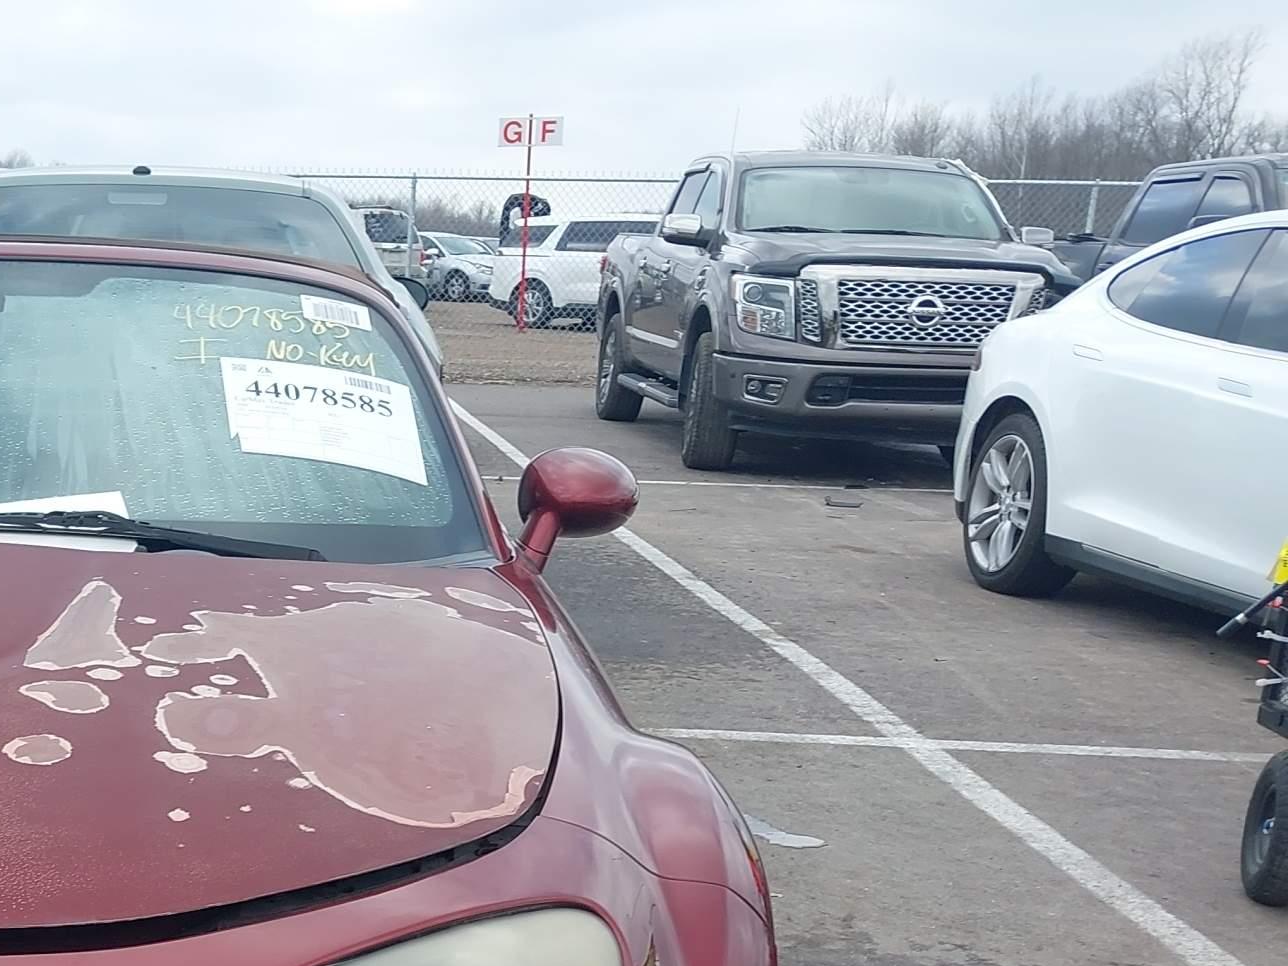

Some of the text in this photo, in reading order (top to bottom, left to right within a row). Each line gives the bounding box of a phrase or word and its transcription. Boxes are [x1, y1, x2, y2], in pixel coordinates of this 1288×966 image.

[503, 120, 523, 144] G
[540, 120, 557, 143] F
[245, 380, 394, 418] 44078585
